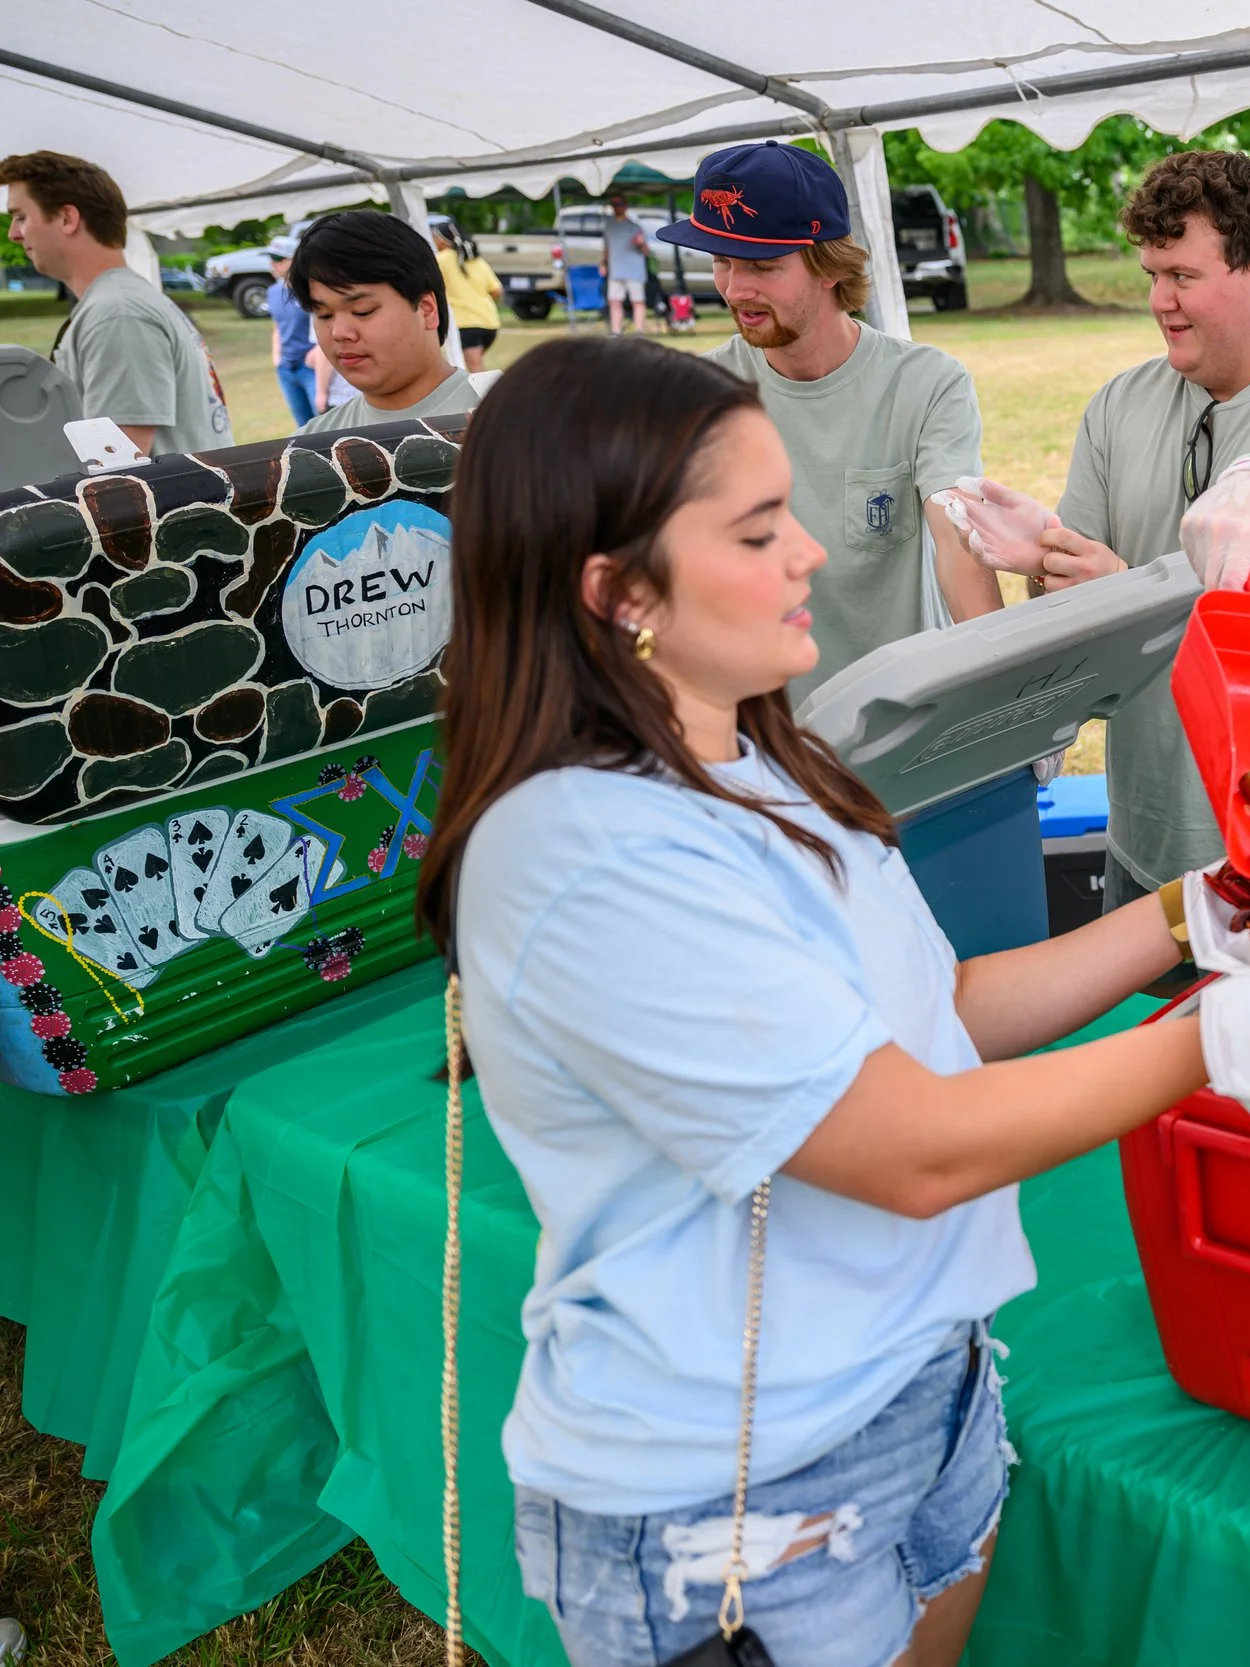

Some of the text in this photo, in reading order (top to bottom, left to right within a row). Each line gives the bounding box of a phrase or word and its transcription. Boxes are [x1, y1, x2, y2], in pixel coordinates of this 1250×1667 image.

[305, 560, 435, 616] DREW
[316, 599, 426, 638] THORNTON
[171, 819, 182, 832] 3
[239, 814, 250, 827] 2
[102, 853, 115, 867] 4
[40, 910, 56, 921] 5
